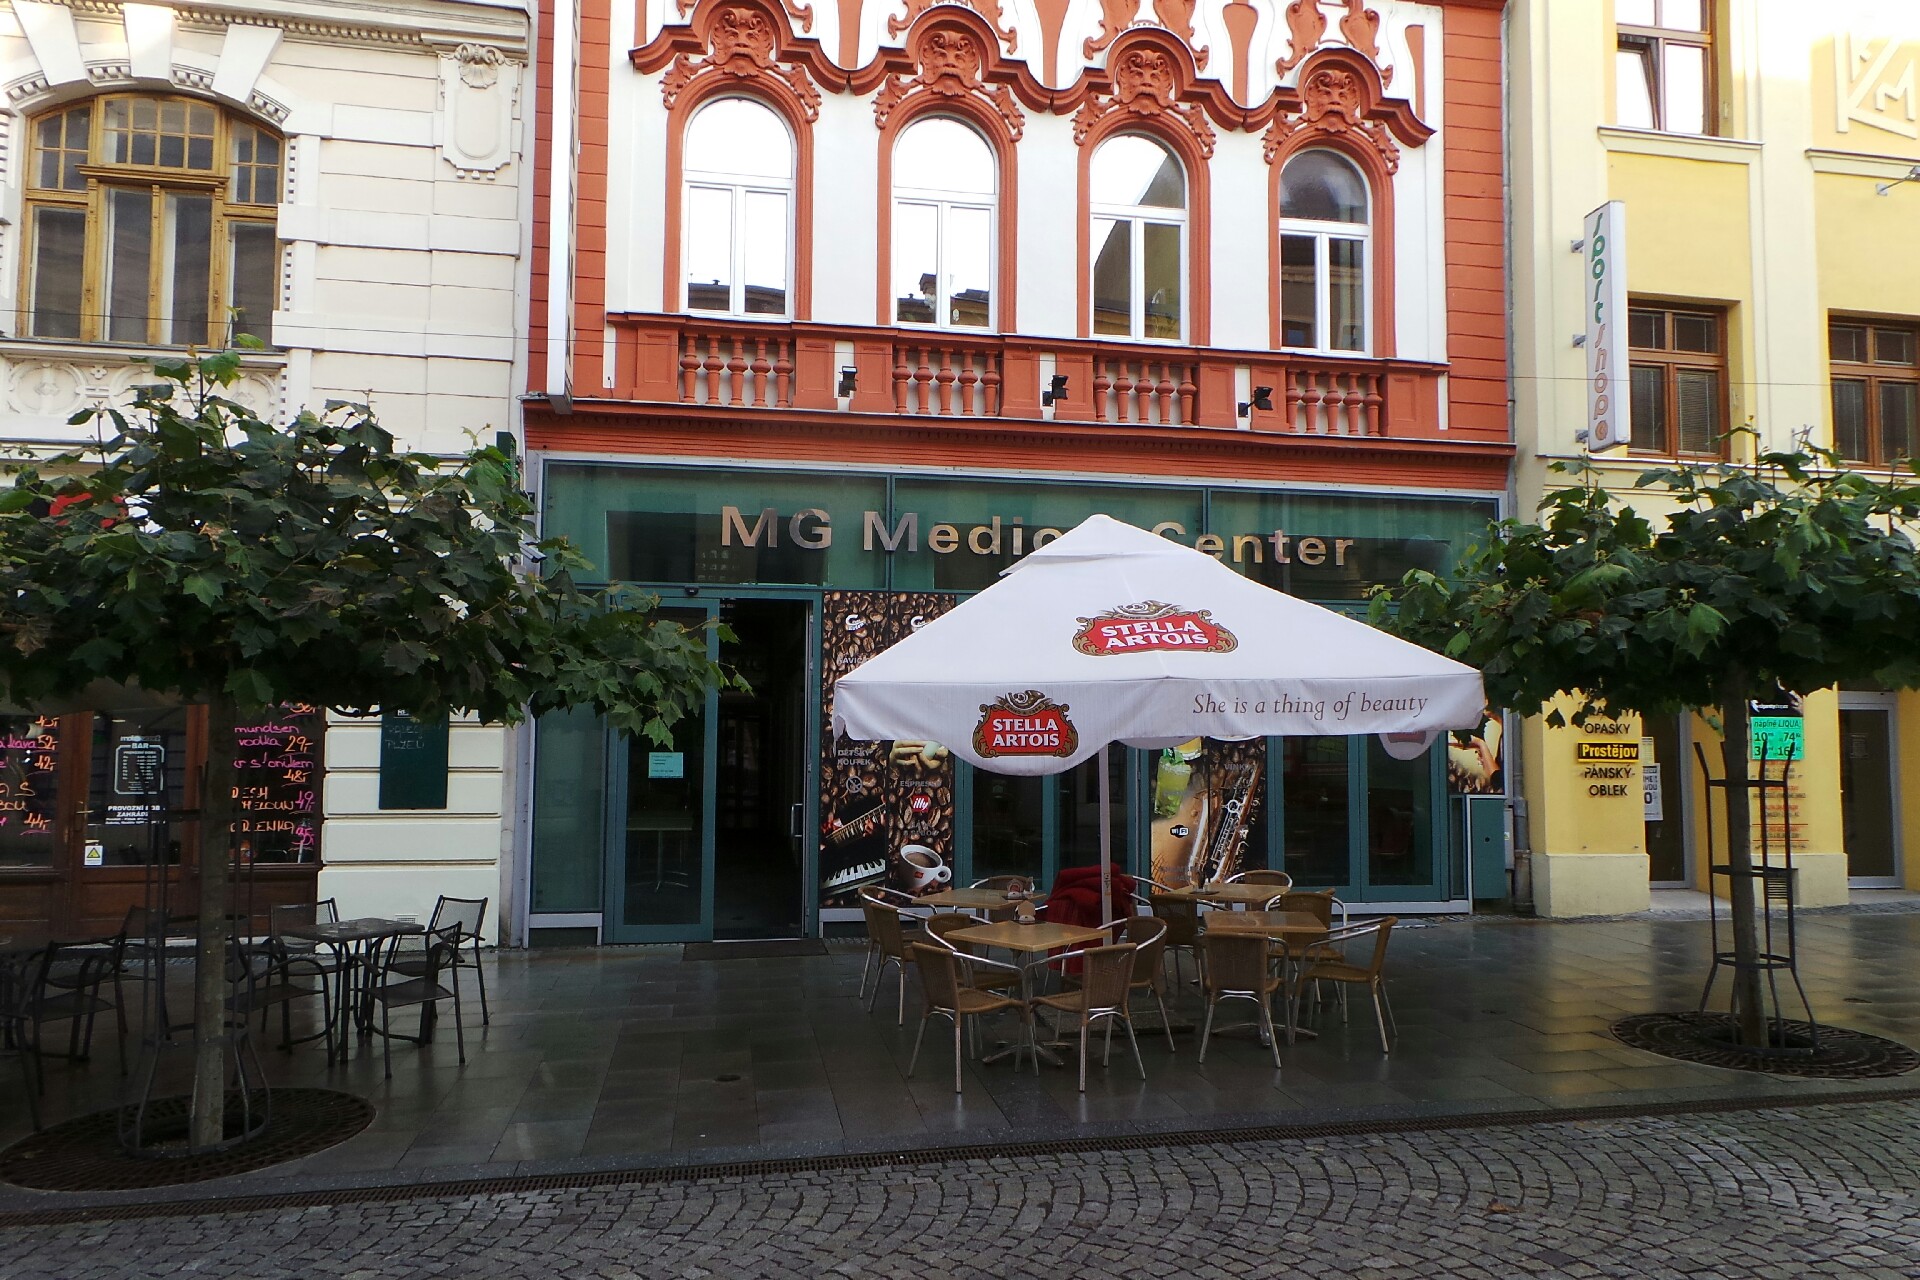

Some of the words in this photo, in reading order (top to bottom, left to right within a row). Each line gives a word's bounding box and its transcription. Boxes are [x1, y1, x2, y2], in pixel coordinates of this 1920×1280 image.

[1591, 213, 1605, 324] sport
[721, 505, 832, 549] MG
[1101, 620, 1203, 637] STELLA
[1105, 632, 1209, 648] ARTOIS
[1193, 694, 1226, 714] She
[1234, 697, 1248, 714] is
[1255, 701, 1266, 714] a
[1274, 694, 1325, 721] thing
[1332, 691, 1356, 721] of
[1360, 693, 1429, 719] beauty
[992, 718, 1059, 732] STELLA
[1584, 722, 1631, 735] OPASKY
[238, 735, 283, 747] vodka
[992, 733, 1060, 747] ARTOIS
[1582, 744, 1638, 759] Prostějov
[1584, 764, 1632, 779] PÁNSKÝ
[1588, 784, 1628, 797] OBLEK
[107, 804, 145, 812] PROVOZNÍ
[913, 797, 930, 811] illy
